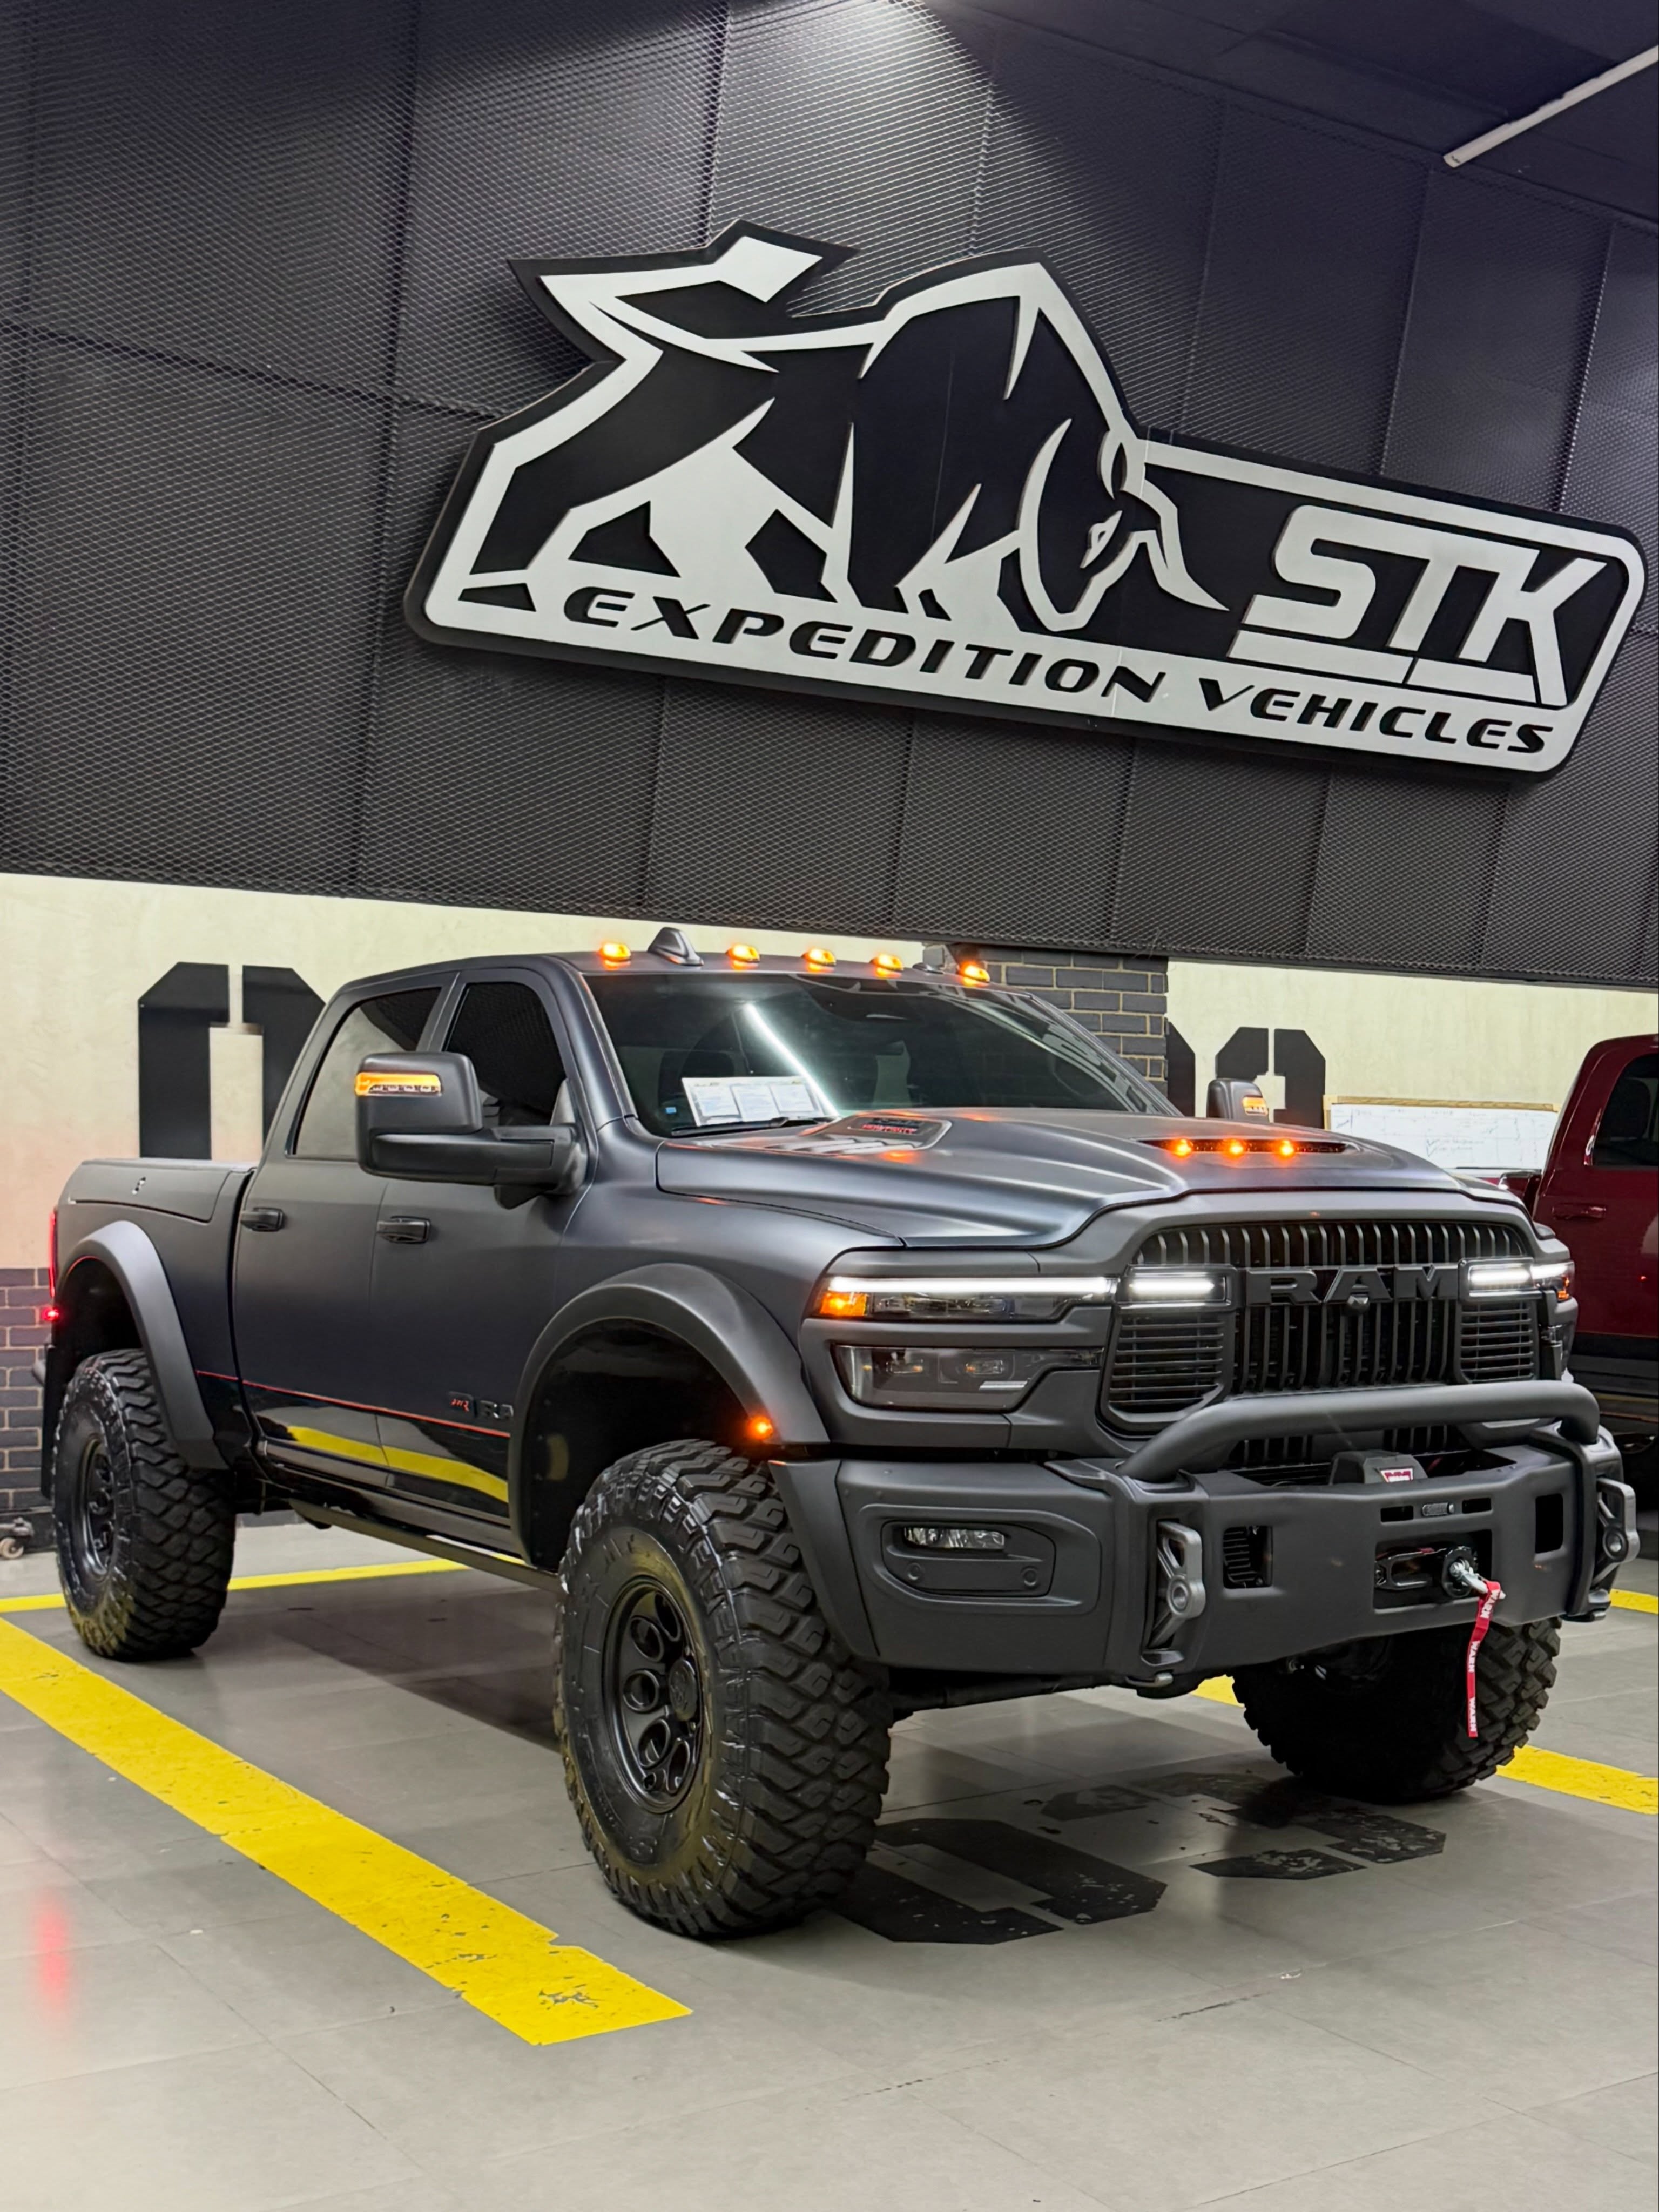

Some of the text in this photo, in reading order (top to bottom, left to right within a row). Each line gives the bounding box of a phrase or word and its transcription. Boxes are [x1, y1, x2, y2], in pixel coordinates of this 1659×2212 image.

[1242, 505, 1608, 706] STK
[563, 585, 1554, 754] EXPEDITION VEHICLES
[1246, 1264, 1459, 1306] RAM
[479, 1399, 514, 1419] RA
[1479, 1589, 1500, 1619] WARN
